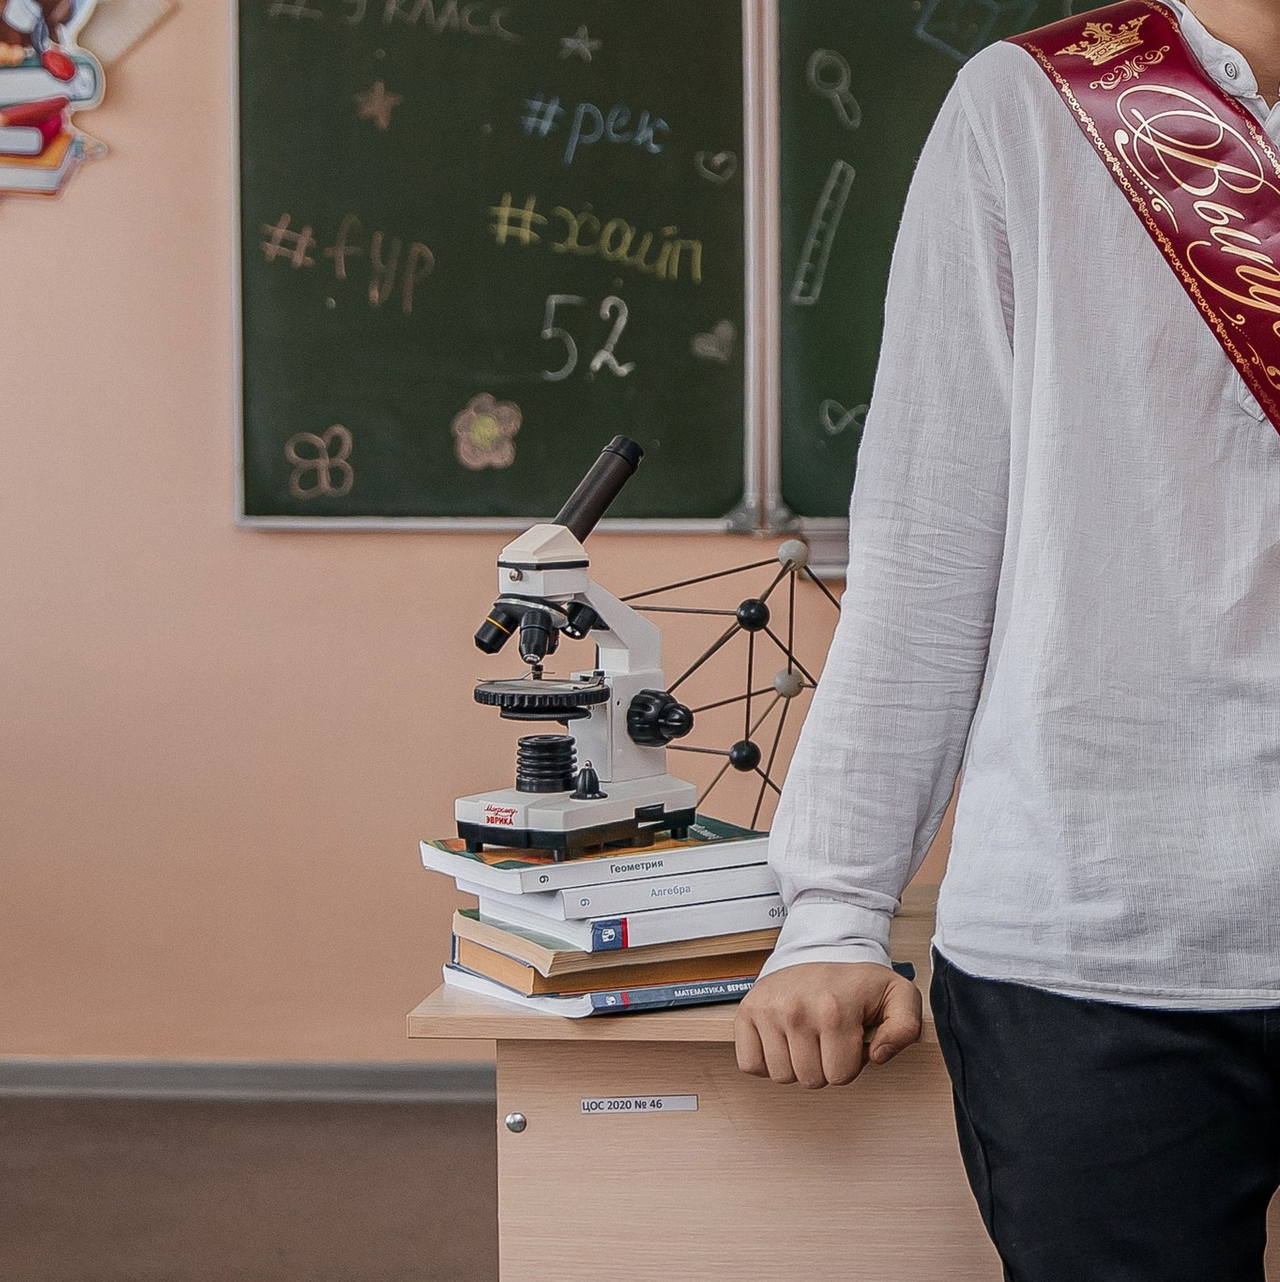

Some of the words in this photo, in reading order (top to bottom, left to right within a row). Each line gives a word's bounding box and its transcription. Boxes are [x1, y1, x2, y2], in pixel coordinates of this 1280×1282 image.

[541, 292, 635, 381] 52
[610, 859, 664, 874] Геометрия
[651, 885, 691, 898] Алгебра
[674, 985, 726, 998] МАТЕМАТИКА
[582, 1101, 604, 1112] ЦОС
[607, 1100, 632, 1110] 2020
[634, 1100, 647, 1110] №
[649, 1099, 663, 1109] 46
